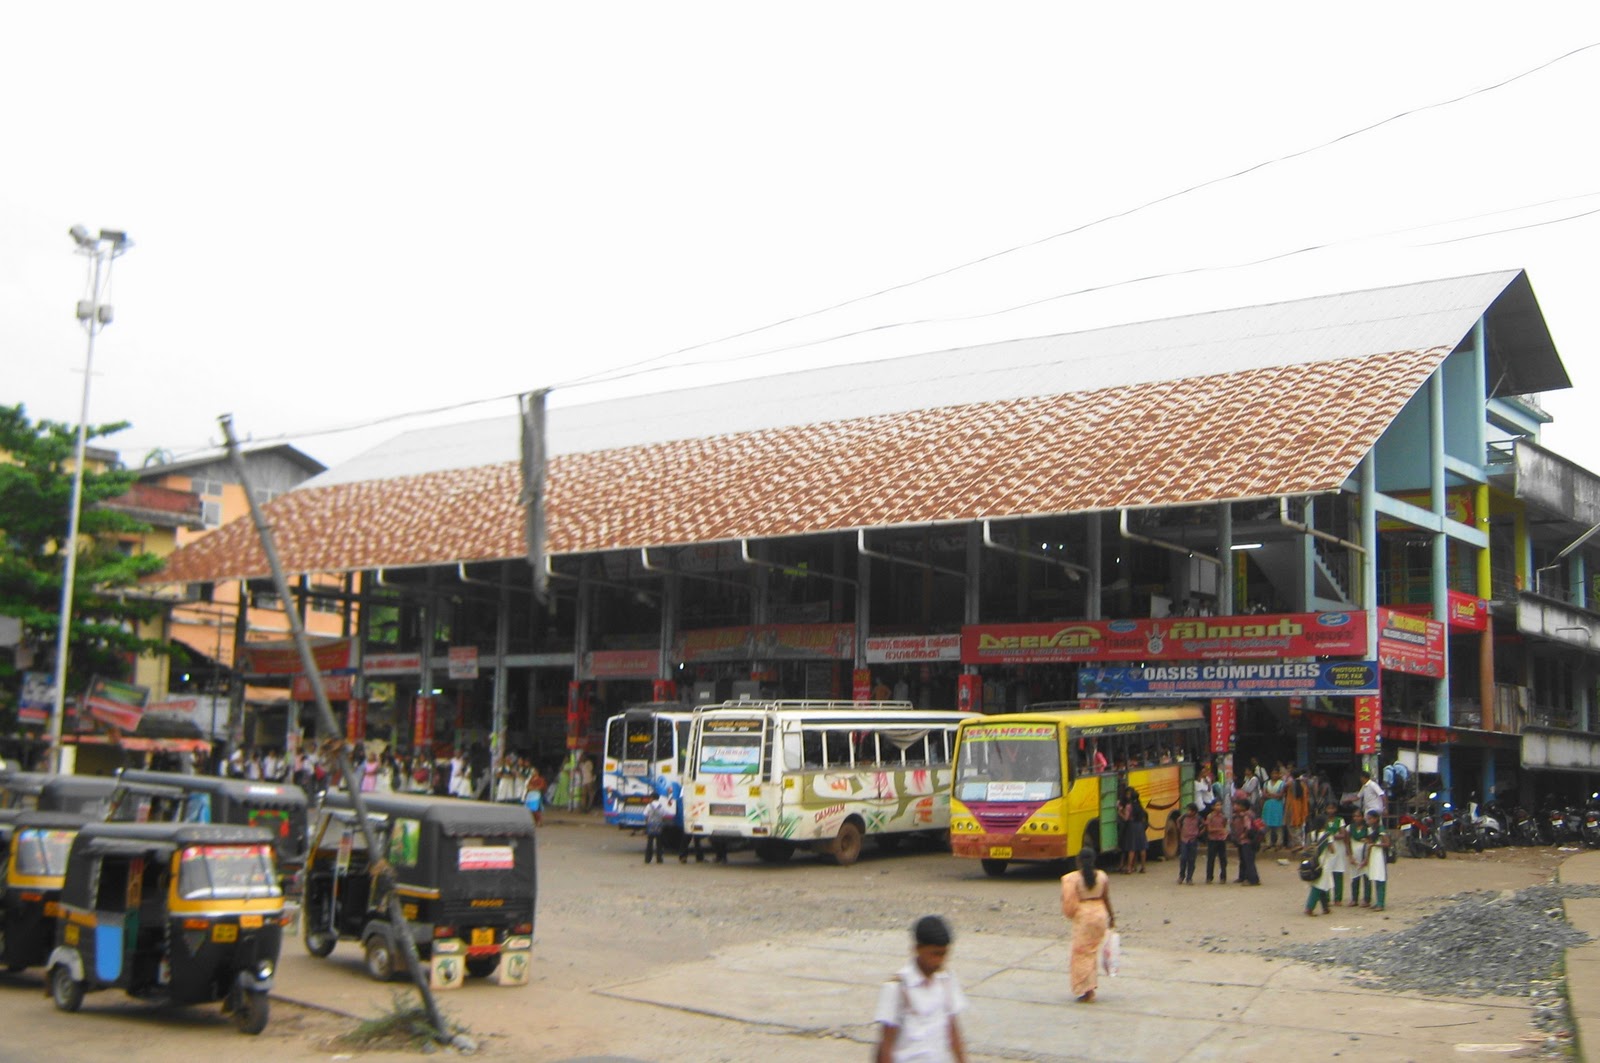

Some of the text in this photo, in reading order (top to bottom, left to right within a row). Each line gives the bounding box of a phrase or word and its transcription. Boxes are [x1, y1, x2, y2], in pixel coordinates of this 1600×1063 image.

[1143, 663, 1321, 681] OASIS COMPUTERS
[1358, 697, 1371, 722] FAX
[1216, 703, 1224, 751] PRINTING
[1358, 727, 1372, 751] DTP
